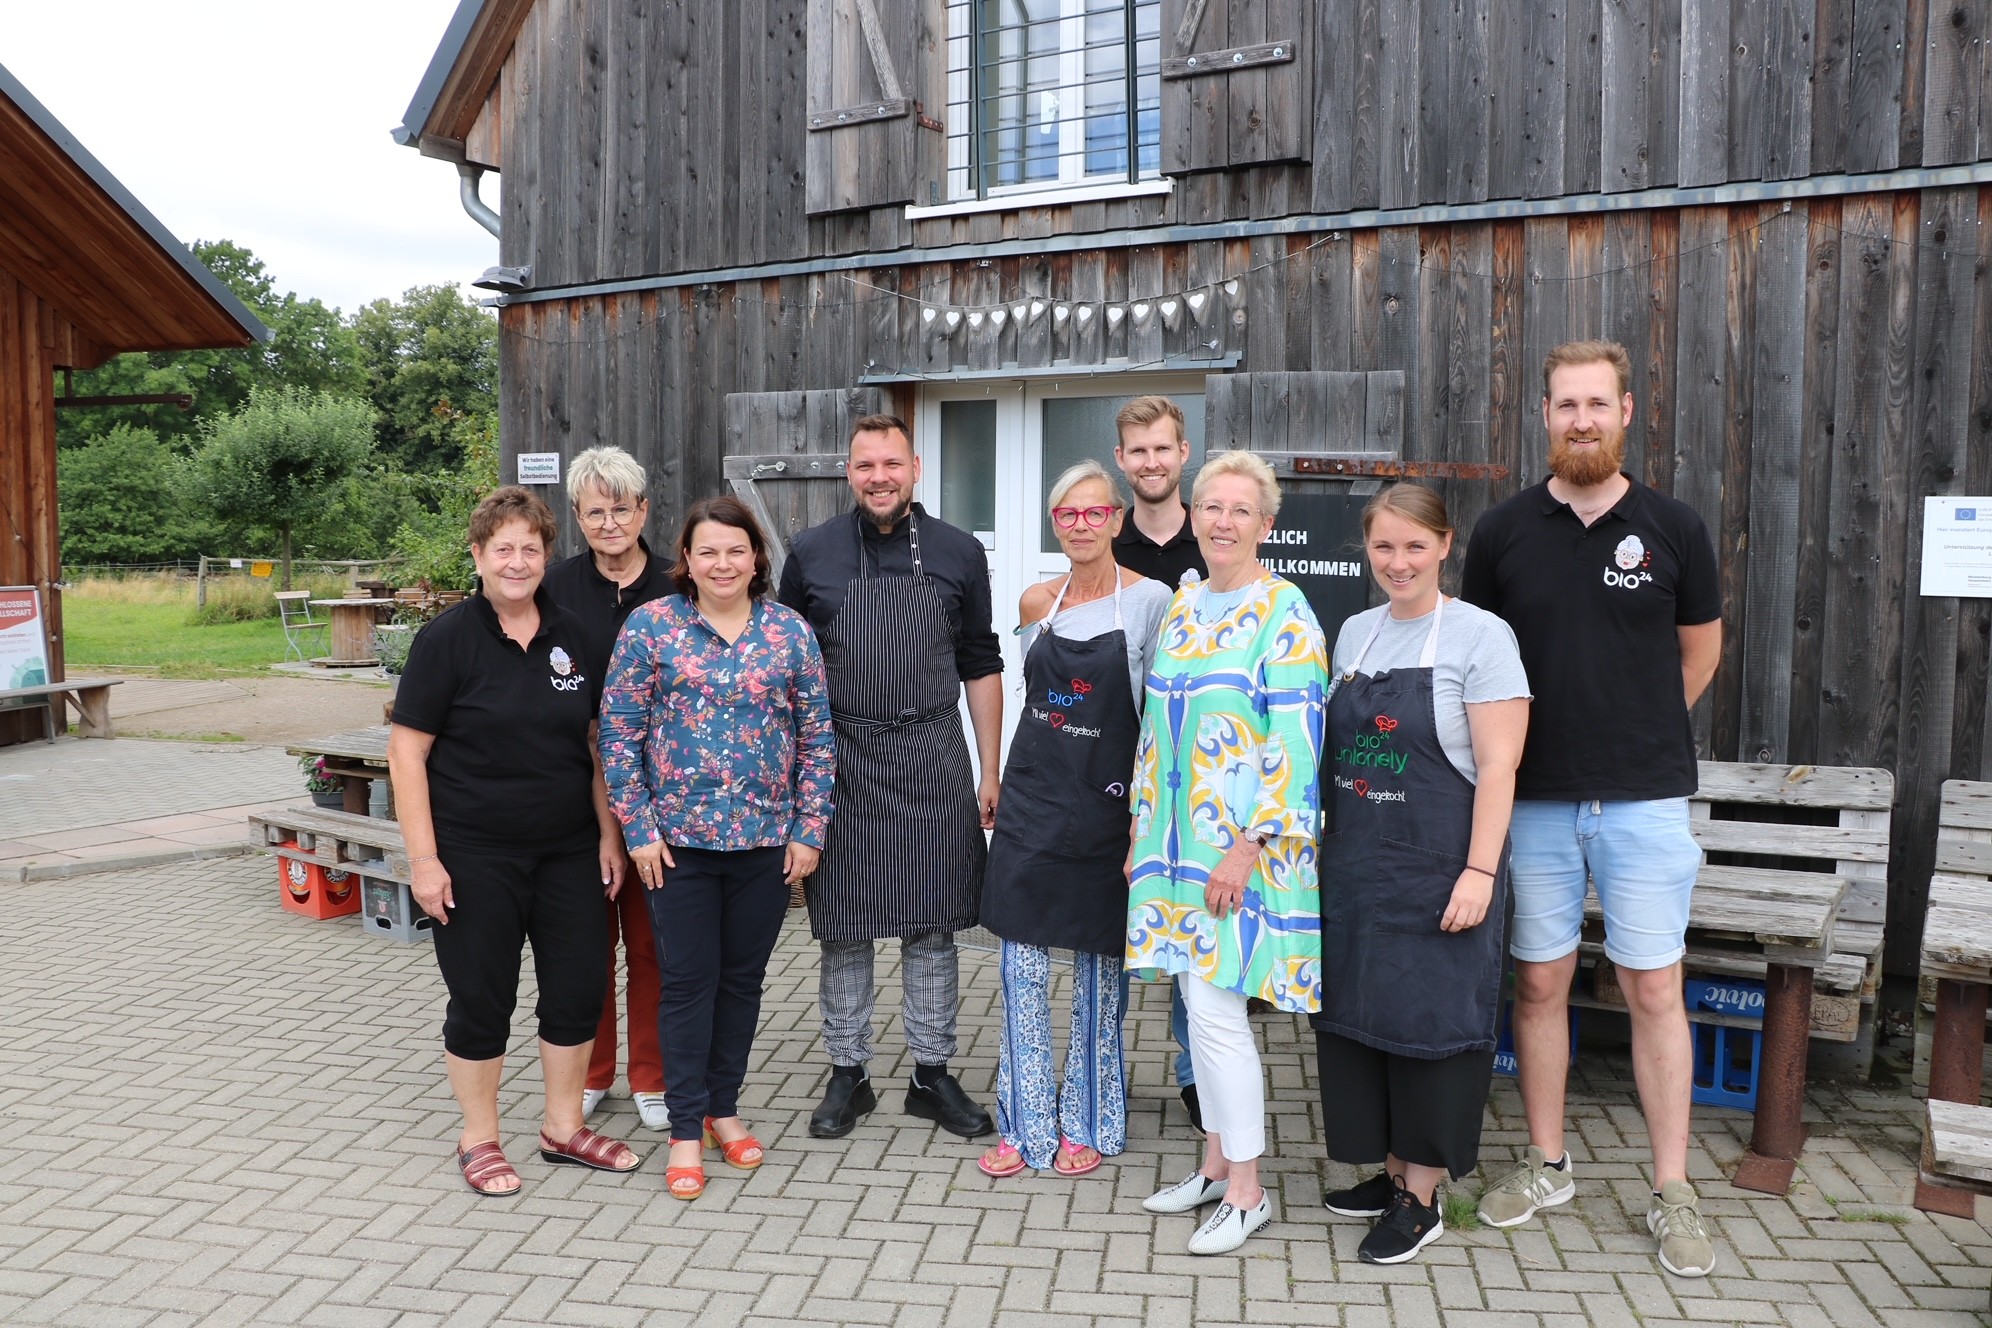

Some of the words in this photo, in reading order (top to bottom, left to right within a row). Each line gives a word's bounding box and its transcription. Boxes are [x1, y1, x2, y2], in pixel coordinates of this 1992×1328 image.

[1038, 710, 1050, 722] viel
[1062, 723, 1101, 738] eingekocht
[1341, 778, 1354, 791] viel
[1366, 789, 1406, 804] eingekocht
[1705, 986, 1765, 1010] olvic
